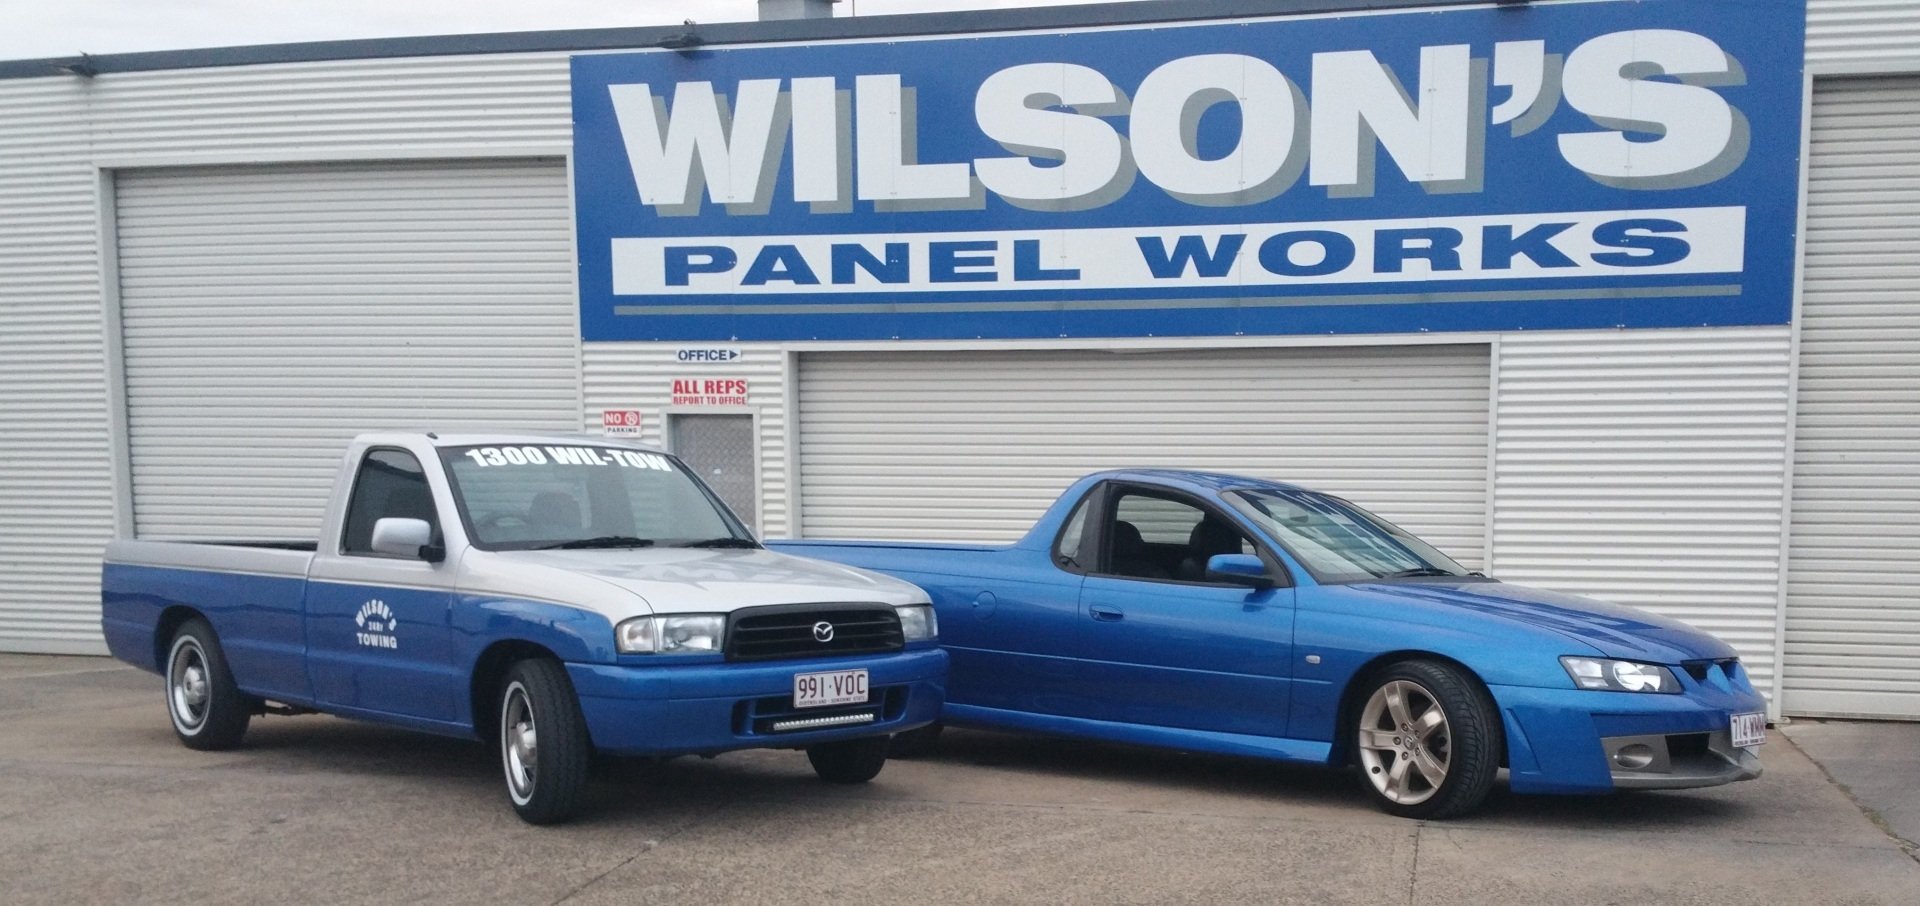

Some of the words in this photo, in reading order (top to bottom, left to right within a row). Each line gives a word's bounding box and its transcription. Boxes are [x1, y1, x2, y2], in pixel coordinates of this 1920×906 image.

[607, 28, 1734, 206] WILSON'S
[664, 239, 1081, 286] PANEL
[1135, 218, 1691, 279] WORKS
[678, 350, 727, 361] OFFICE
[673, 380, 700, 394] ALL
[704, 380, 747, 394] REPS
[673, 396, 704, 405] REPORT
[706, 396, 717, 405] TO
[719, 396, 746, 405] OFFICE
[605, 412, 622, 424] NO
[465, 447, 547, 467] 1300
[544, 447, 672, 472] WIL-TOW
[356, 599, 397, 631] WILSON'S
[356, 632, 397, 649] TOWING
